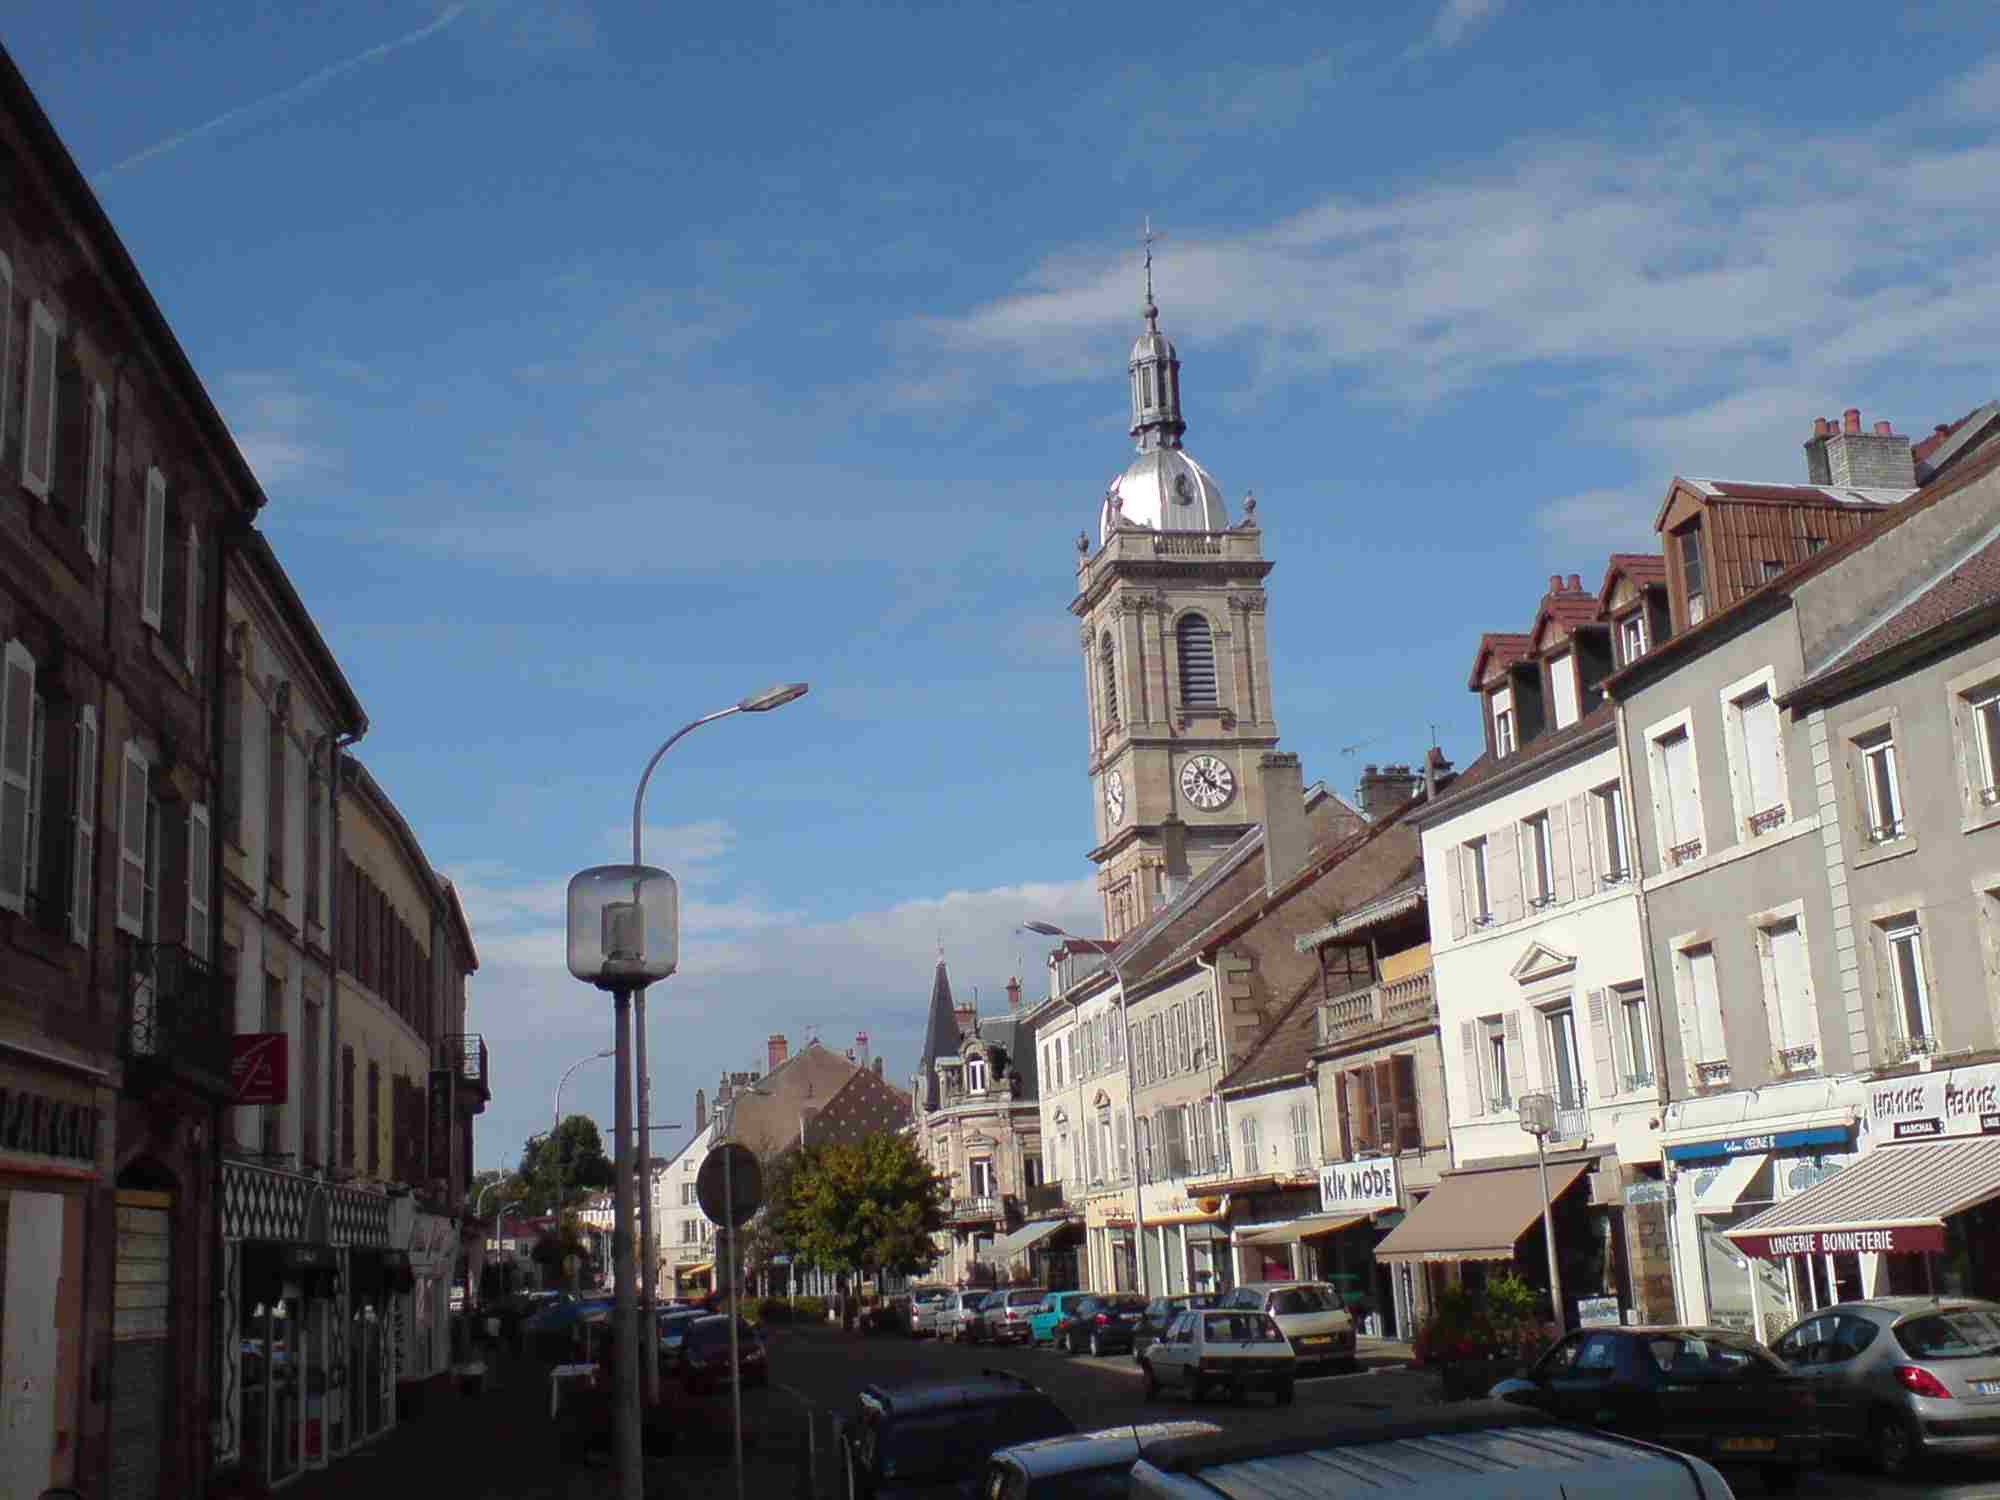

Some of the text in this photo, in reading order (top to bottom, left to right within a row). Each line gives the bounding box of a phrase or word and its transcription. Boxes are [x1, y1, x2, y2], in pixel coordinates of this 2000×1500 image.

[1873, 1084, 1997, 1119] HOMMES FEMMES
[1323, 1164, 1393, 1200] KIK MODE
[1768, 1230, 1894, 1255] LINGERIE BONNETERIE
